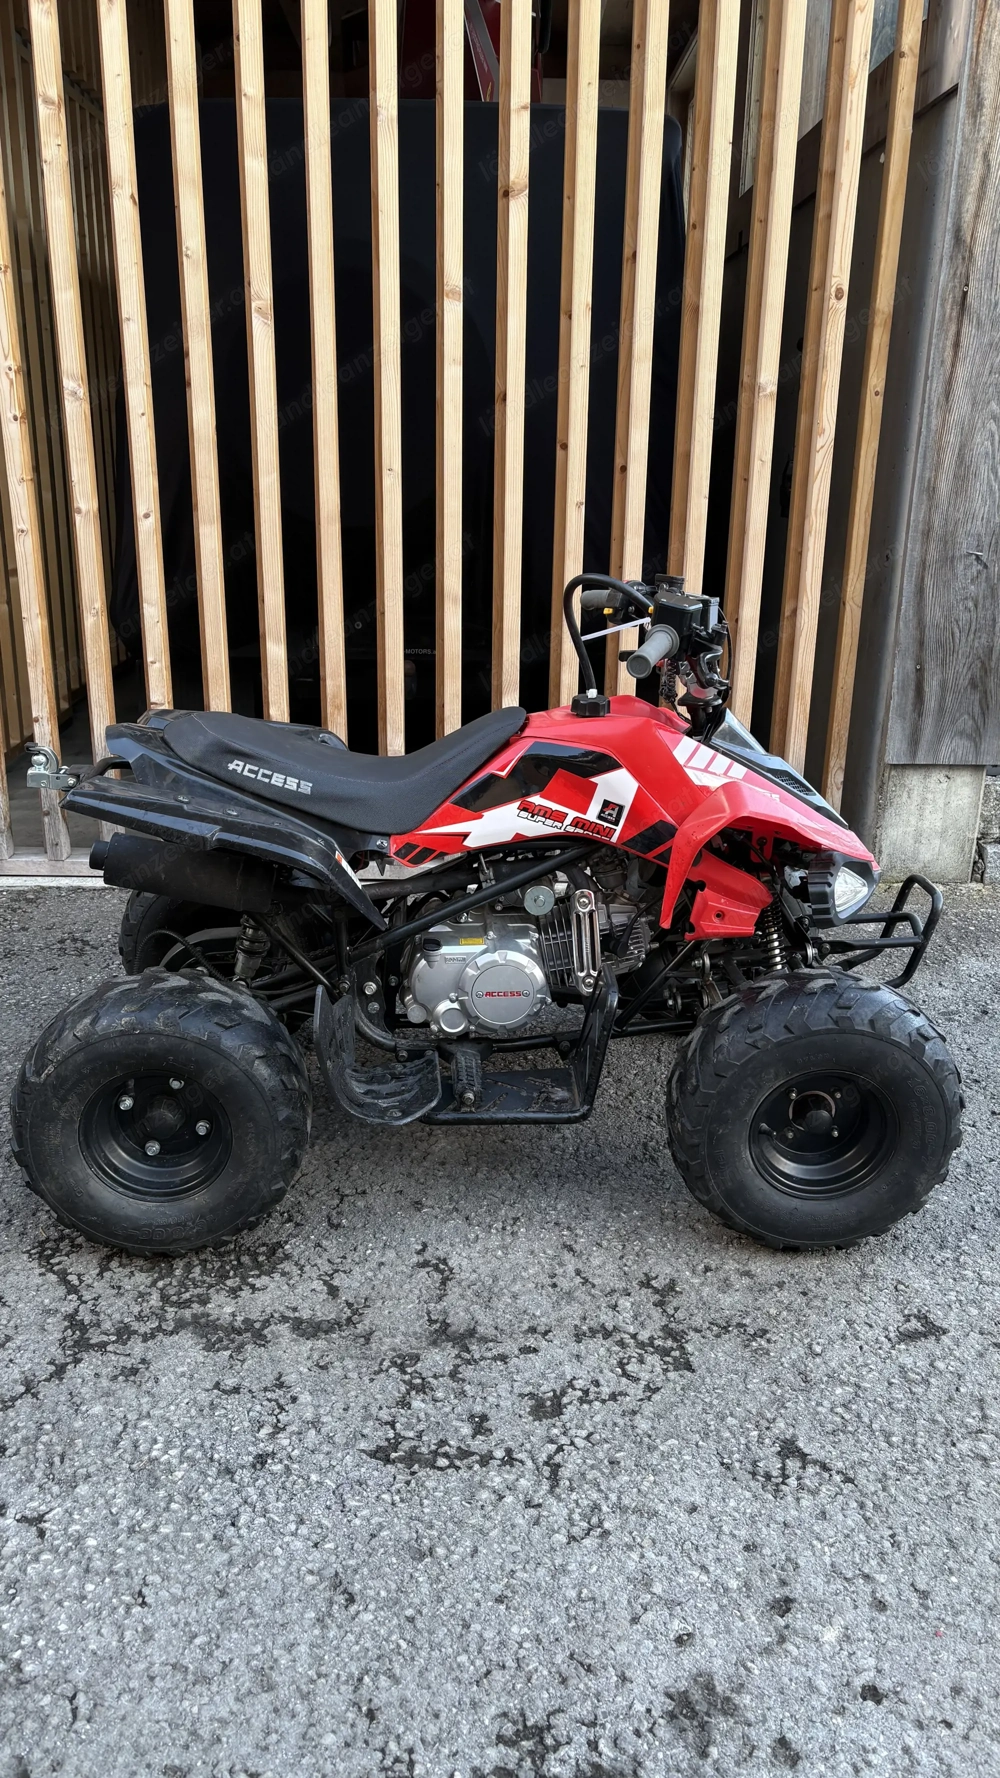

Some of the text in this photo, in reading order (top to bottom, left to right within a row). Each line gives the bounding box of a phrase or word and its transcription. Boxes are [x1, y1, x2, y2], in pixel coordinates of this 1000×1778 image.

[227, 759, 313, 795] ACCESS
[517, 800, 617, 839] AMS MINI
[517, 810, 612, 841] SUPER SPO
[484, 990, 522, 998] ACCESS
